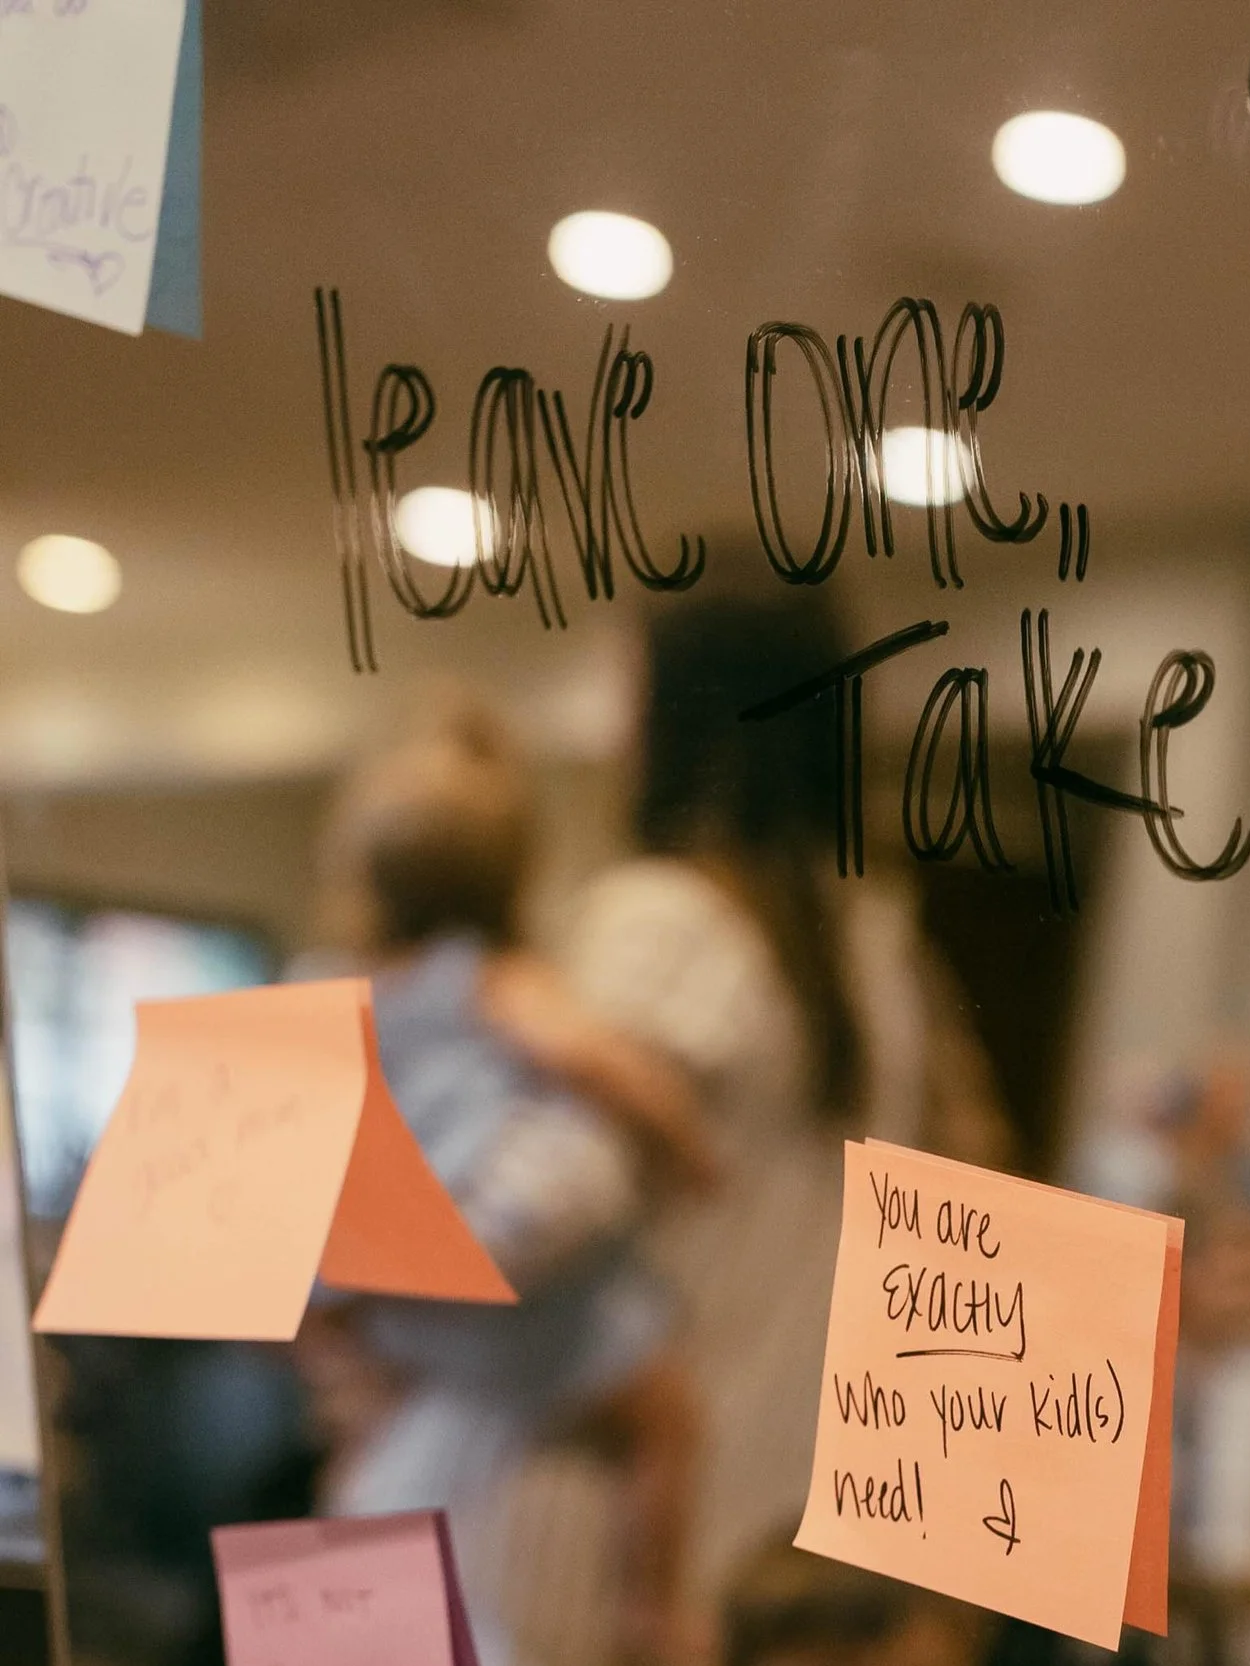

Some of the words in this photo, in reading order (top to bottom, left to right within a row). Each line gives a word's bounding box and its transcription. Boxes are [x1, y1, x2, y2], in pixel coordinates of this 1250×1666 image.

[936, 1200, 1002, 1260] are
[930, 1384, 1008, 1459] your
[833, 1457, 928, 1540] need!
